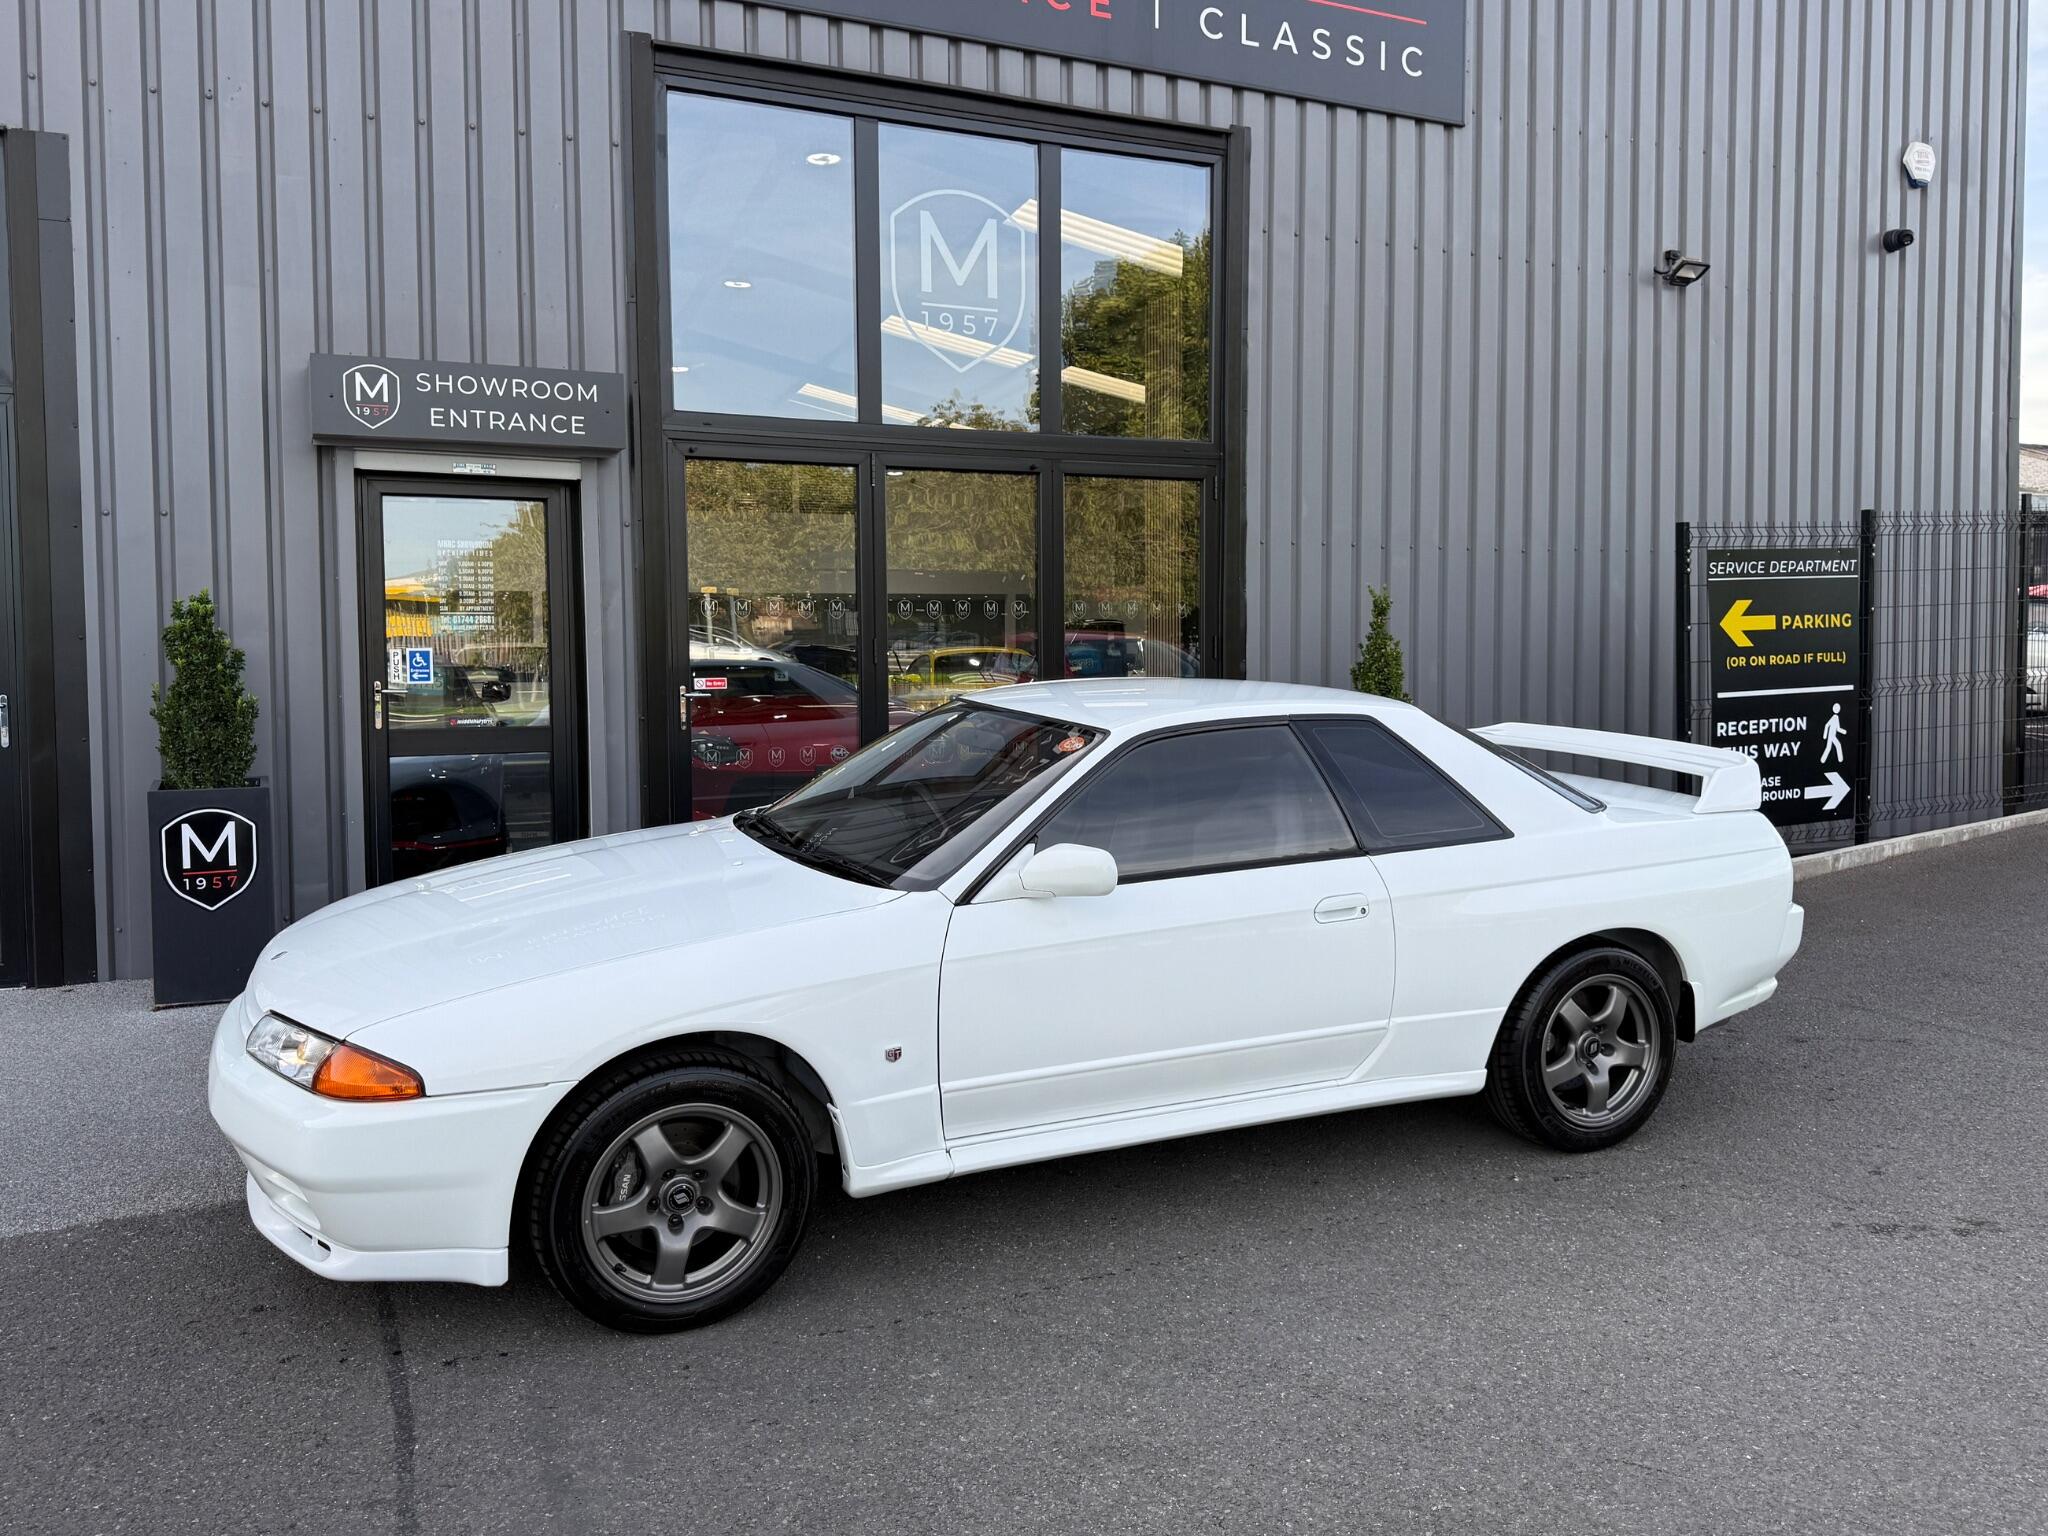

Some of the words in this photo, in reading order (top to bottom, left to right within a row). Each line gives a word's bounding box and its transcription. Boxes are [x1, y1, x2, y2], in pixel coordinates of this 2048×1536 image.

[1199, 7, 1425, 78] CLASSIC
[919, 210, 998, 299] M
[921, 311, 998, 337] 1957
[355, 371, 389, 403] M
[416, 372, 598, 403] SHOWROOM
[355, 406, 389, 417] 1957
[430, 407, 586, 435] ENTRANCE
[1708, 561, 1765, 575] SERVICE
[1769, 559, 1858, 573] DEPARTMENT
[704, 601, 715, 610] M
[737, 601, 748, 611] M
[769, 601, 780, 611] M
[801, 601, 811, 610] M
[832, 602, 842, 611] M
[900, 602, 910, 612] M
[929, 602, 939, 612] M
[958, 602, 968, 612] M
[986, 602, 996, 612] M
[1014, 602, 1023, 612] M
[1075, 602, 1084, 612] M
[1782, 613, 1852, 630] PARKING
[392, 651, 400, 681] PUSH
[1726, 656, 1747, 670] (OR
[1750, 655, 1766, 666] ON
[1769, 653, 1801, 665] ROAD
[1803, 652, 1814, 664] IF
[1817, 651, 1847, 664] FULL)
[1716, 716, 1808, 737] RECEPTION
[739, 751, 750, 761] M
[771, 750, 782, 760] M
[802, 748, 813, 758] M
[1763, 741, 1801, 759] WAY
[706, 752, 717, 762] M
[1761, 776, 1781, 788] ASE
[1762, 788, 1801, 802] ROUND
[181, 820, 237, 869] M
[183, 875, 238, 891] 1957
[618, 1174, 632, 1201] SSAN
